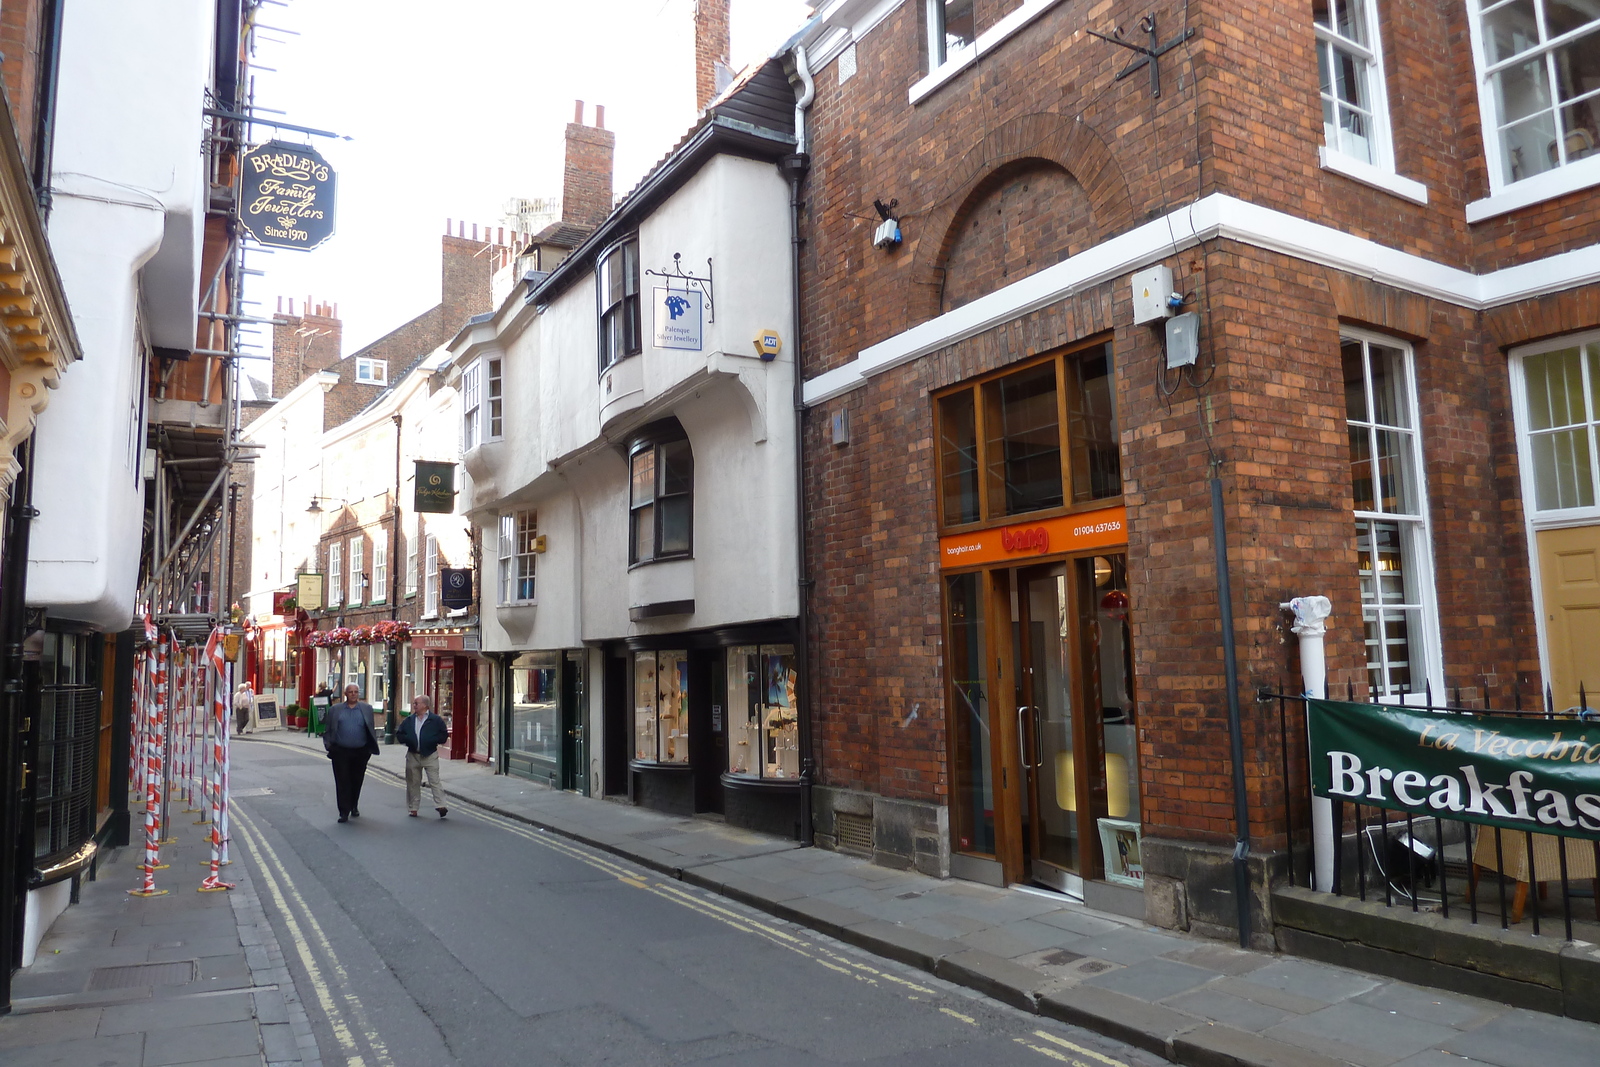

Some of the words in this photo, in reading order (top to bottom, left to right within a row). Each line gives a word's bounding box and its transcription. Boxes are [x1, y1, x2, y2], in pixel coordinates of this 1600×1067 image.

[250, 153, 329, 182] BRADLEYS
[258, 179, 316, 204] Family
[249, 196, 324, 219] Jewellers
[264, 225, 288, 239] Since
[288, 228, 308, 241] 1970
[656, 333, 673, 341] Silver
[673, 335, 698, 344] Jewellery
[664, 325, 690, 335] Palenque
[764, 336, 777, 347] ADT
[1073, 523, 1094, 537] 01904
[1095, 520, 1121, 534] 637636
[1000, 526, 1050, 554] bang
[946, 542, 982, 556] banghair.co.uk
[1417, 724, 1461, 751] La
